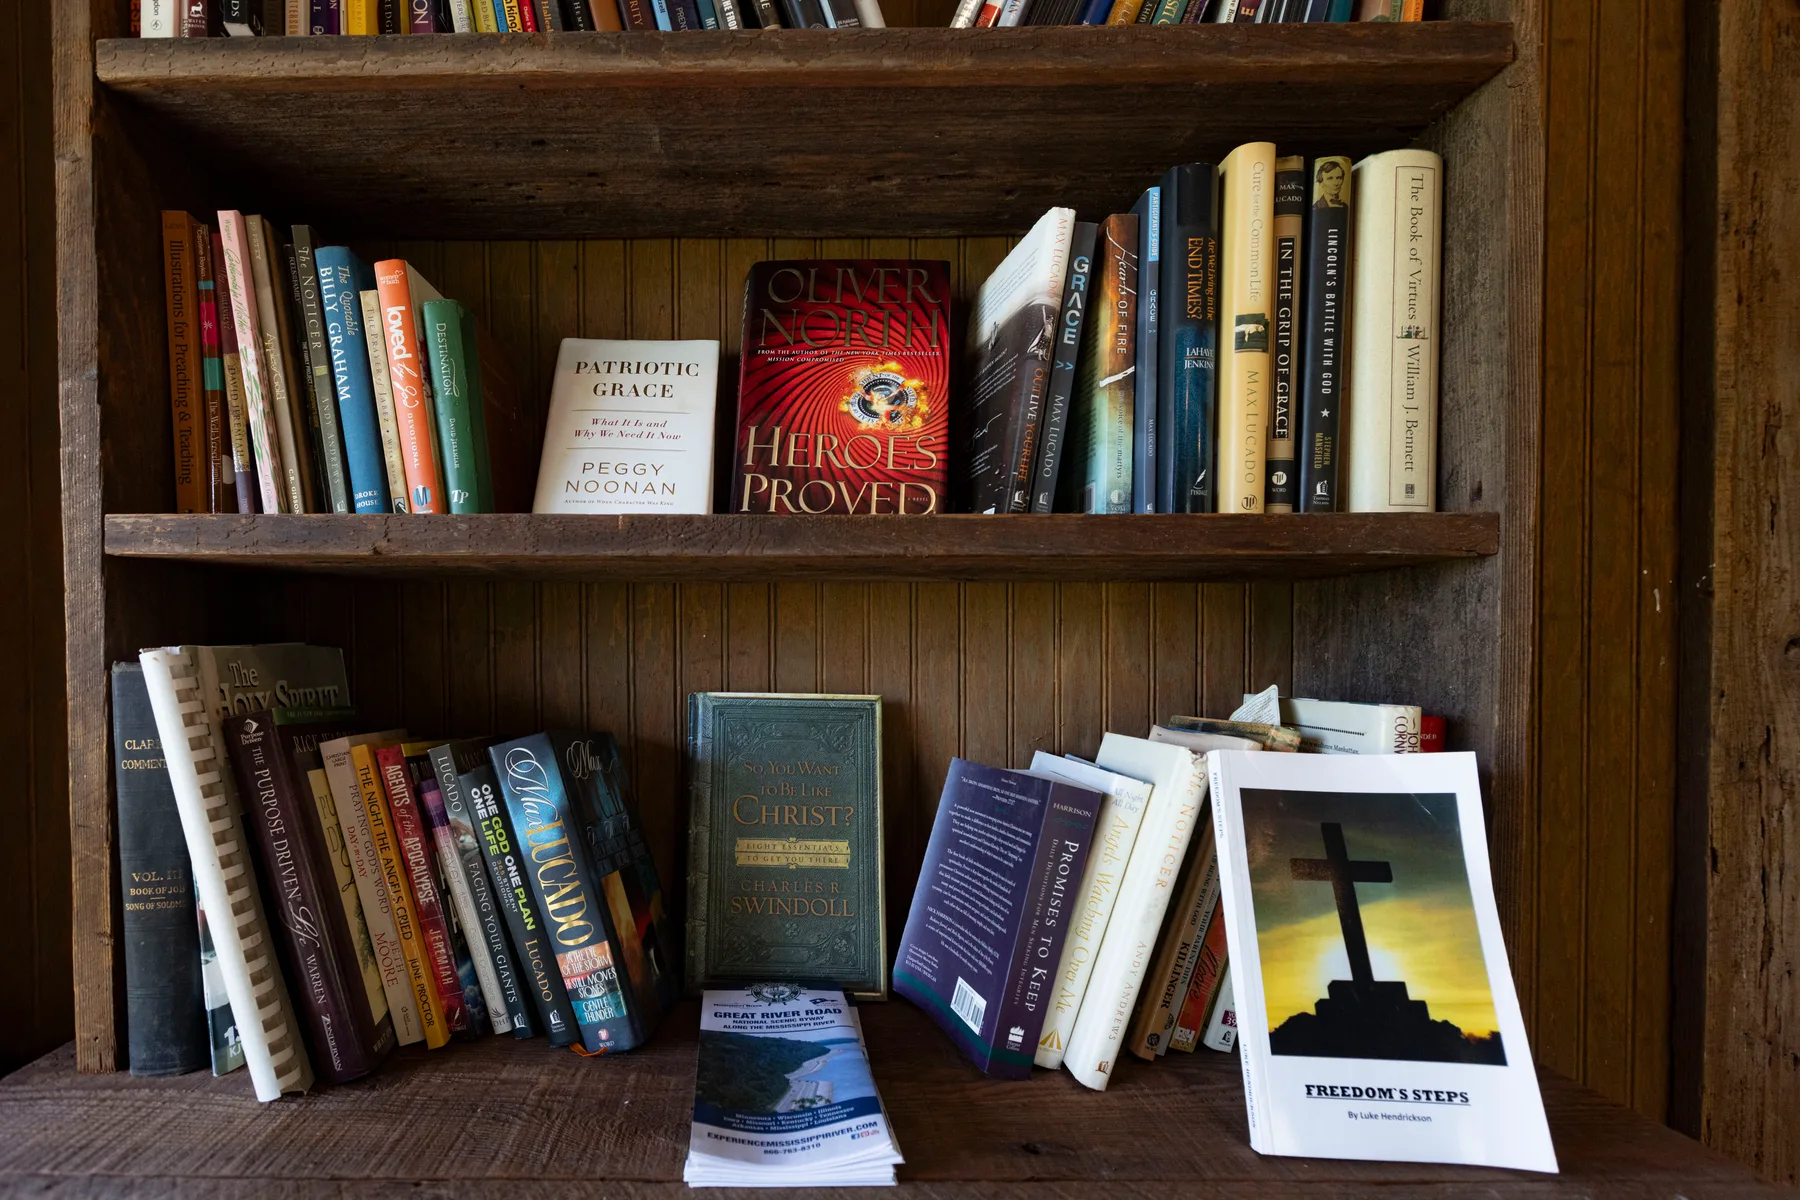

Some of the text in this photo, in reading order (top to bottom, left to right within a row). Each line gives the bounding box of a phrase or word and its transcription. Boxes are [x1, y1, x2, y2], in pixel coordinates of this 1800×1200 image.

[1139, 1, 1153, 23] WHY
[1279, 183, 1296, 191] MAX
[1250, 161, 1265, 279] Cure Common
[1408, 173, 1425, 321] The Book of Virtues
[170, 240, 185, 318] Illustrations
[768, 267, 942, 304] OLIVER
[1048, 217, 1068, 300] MAX LUCADO
[1187, 237, 1203, 320] END TIMES?
[298, 246, 322, 349] The NOTICER
[338, 266, 358, 336] The Quotable
[1063, 256, 1090, 345] GRACE
[1321, 228, 1338, 394] LINCOLN'S BATTLE WITH GOD
[174, 321, 189, 340] for
[320, 266, 351, 401] BILLY GRAHAM
[386, 305, 412, 360] loved
[758, 308, 941, 348] NORTH
[1117, 300, 1128, 354] OF FIRE
[1276, 241, 1292, 438] IN THE GRIP OF GRACE
[175, 344, 191, 409] Preaching
[371, 333, 389, 423] PRAYER JABEZ
[436, 322, 456, 396] DESTINATION
[573, 360, 700, 377] PATRIOTIC
[1185, 359, 1214, 370] JENKINS
[179, 411, 192, 422] &
[227, 365, 246, 458] DAVID JEREMIAH
[592, 383, 674, 399] GRACE
[1027, 367, 1044, 421] OUTLIVE
[1404, 343, 1421, 473] William Bennett
[321, 396, 340, 484] ANDY ANDREWS
[407, 412, 419, 468] DEVOTIONAL
[574, 429, 682, 440] Why We Need It Now
[591, 418, 668, 428] What It Is and
[743, 425, 937, 470] HEROES
[1043, 394, 1065, 478] MAX LUCADO
[1244, 370, 1260, 484] MAX LUCADO
[1314, 432, 1324, 469] MANSFIELD
[179, 427, 194, 485] Teaching
[582, 462, 665, 476] PEGGY
[1323, 436, 1332, 466] STEPHEN
[565, 480, 676, 496] NOONAN
[740, 473, 937, 514] PROVED
[228, 660, 258, 688] The
[437, 756, 464, 813] LUCADO
[1052, 802, 1092, 819] HARRISON
[349, 784, 390, 914] PRAYING GOD'S WORD
[385, 765, 435, 906] AGENTS APOCALYPSE
[471, 787, 500, 857] ONE LIFE
[504, 747, 594, 947] Max LUCADO
[746, 843, 840, 852] EIGHT ESSENTIALS
[1155, 804, 1191, 890] NOTICER
[131, 871, 165, 883] VOL.
[347, 825, 368, 878] DAY DAY
[481, 783, 536, 931] ONE GOD ONE PLAN
[746, 855, 759, 863] TO
[785, 856, 804, 864] YOU
[808, 856, 840, 864] THERE
[129, 887, 166, 897] BOOK OF
[251, 746, 343, 1072] THE PURPOSE DRIVEN WARREN ZONDERVAN
[359, 765, 435, 1028] THE NIGHT THE ANGELS CRIED JUNE PROCTOR
[730, 896, 855, 917] SWINDOLL
[741, 880, 824, 894] CHARLES
[1055, 815, 1130, 1014] Angels Watching Over Me
[468, 862, 518, 1003] FACING YOUR GIANTS
[1025, 840, 1080, 1013] PROMISES TO KEEP
[374, 931, 399, 988] MOORE
[429, 928, 454, 985] JEREMIAH
[524, 939, 554, 1003] LUCADO
[586, 967, 617, 985] MOVES
[1160, 941, 1190, 1010] KILLINGER
[578, 983, 605, 999] STONES
[582, 997, 608, 1012] GENTLE
[585, 1008, 615, 1024] THUNDER
[713, 1008, 843, 1020] GREAT RIVER ROAD
[1108, 941, 1148, 1042] ANDY ANDREWS
[766, 1022, 812, 1031] MISSISSIPPI
[1305, 1083, 1470, 1105] FREEDOM'S STEPS
[1347, 1111, 1433, 1124] By Luke Hendrickson
[707, 1121, 878, 1148] EXPERIENCEMISSISSIPPIRIVER.COM
